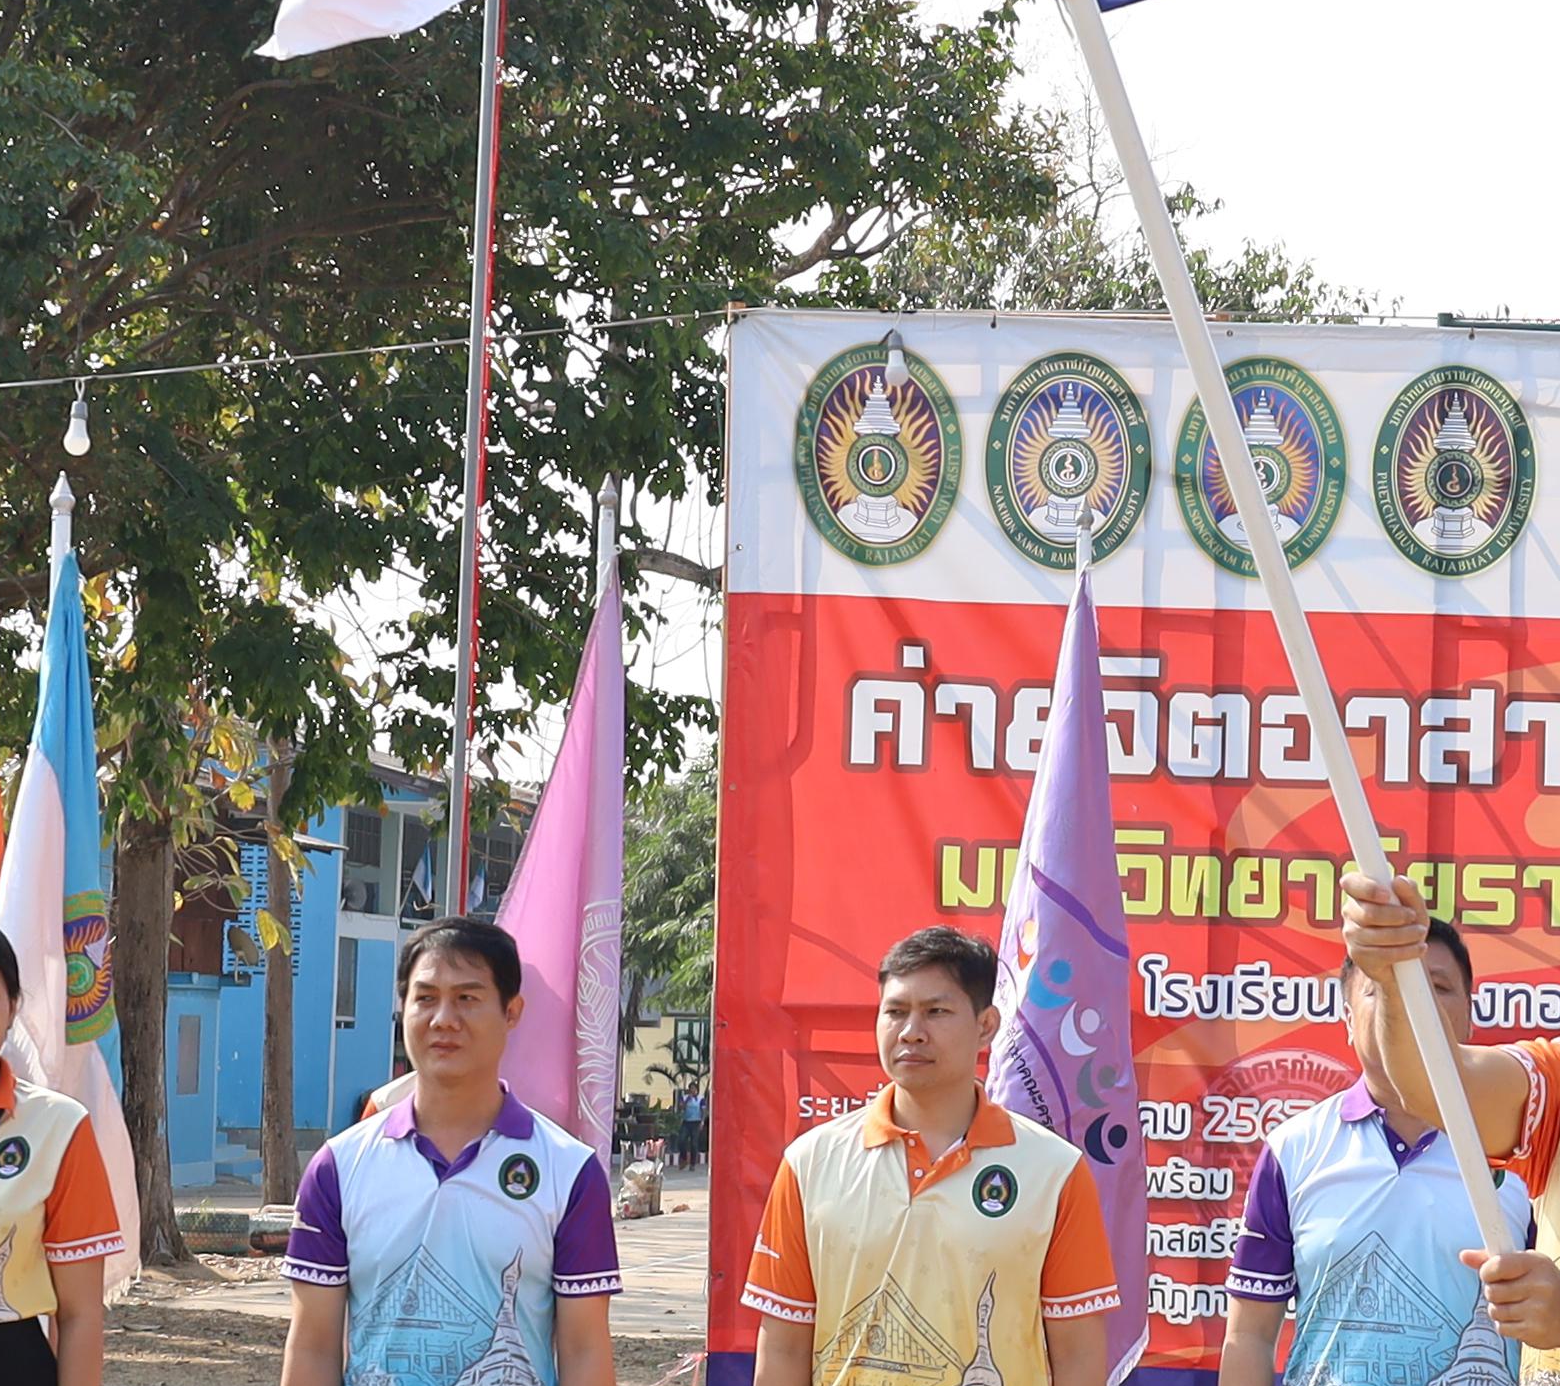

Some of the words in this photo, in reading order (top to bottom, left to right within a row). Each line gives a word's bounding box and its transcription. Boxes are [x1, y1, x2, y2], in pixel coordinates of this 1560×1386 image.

[827, 527, 858, 555] PHET
[865, 530, 933, 562] RAJABHAT
[931, 443, 961, 525] UNIVERSITY
[992, 484, 1018, 536] NAKHON
[1014, 531, 1045, 558] SAWAN
[1101, 488, 1142, 550] UNIVERSITY
[1302, 477, 1340, 549] UNIVERSITY
[1375, 472, 1418, 556] PHETCHABUN
[1422, 549, 1495, 574] RAJABHAT
[1498, 475, 1533, 549] UNIVERSITY
